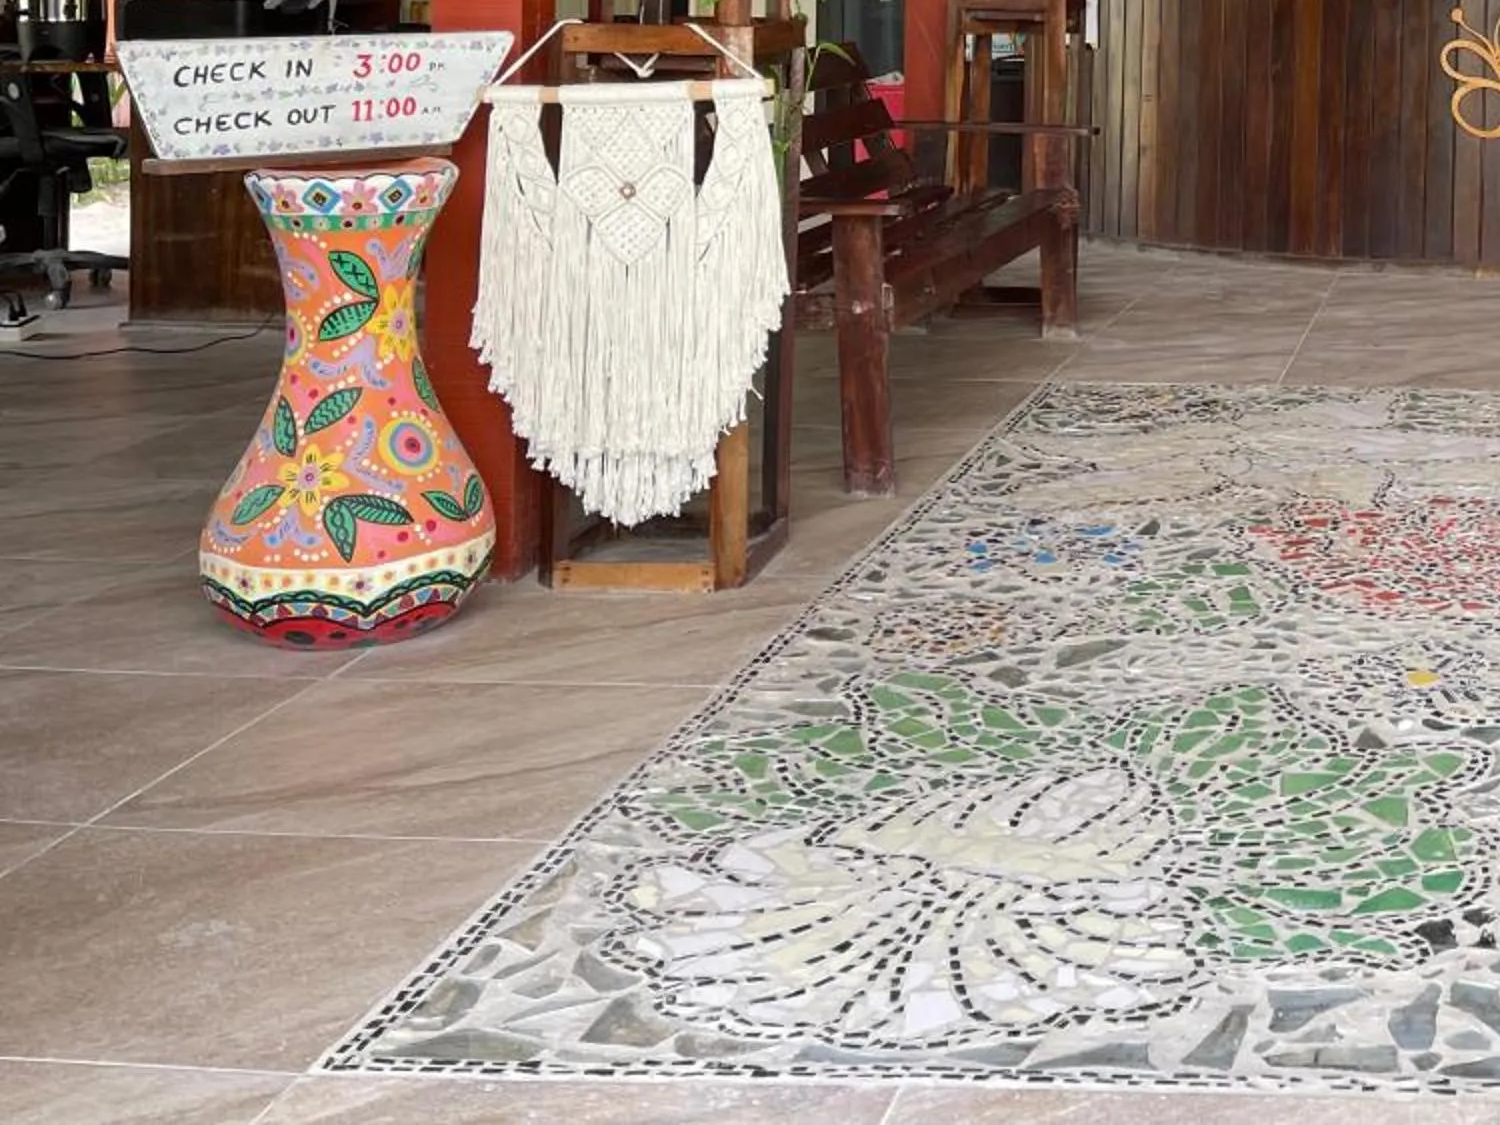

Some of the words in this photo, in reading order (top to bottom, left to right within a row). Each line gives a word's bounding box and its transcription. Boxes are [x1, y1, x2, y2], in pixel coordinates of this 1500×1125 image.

[173, 60, 267, 88] CHECK
[285, 58, 313, 78] IN
[353, 52, 421, 78] 3:00
[173, 110, 273, 135] CHECK
[286, 104, 337, 126] OUT
[351, 96, 417, 122] 11:00
